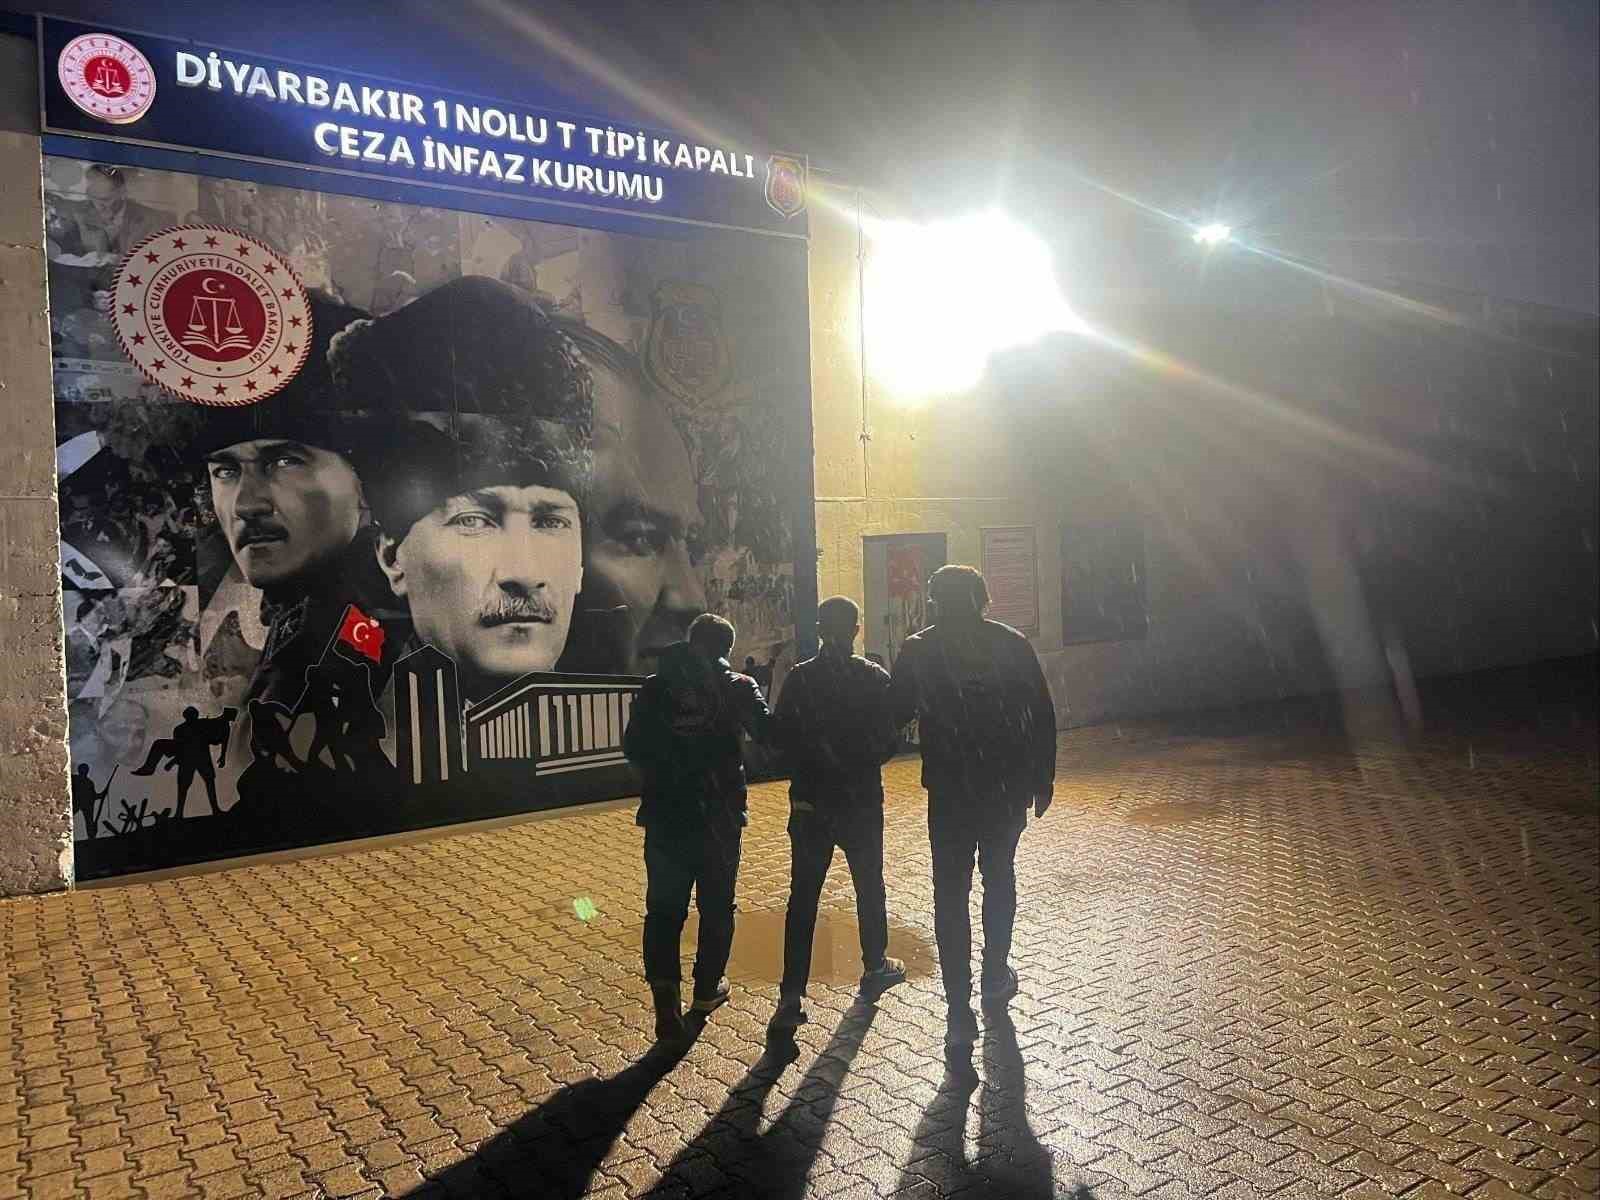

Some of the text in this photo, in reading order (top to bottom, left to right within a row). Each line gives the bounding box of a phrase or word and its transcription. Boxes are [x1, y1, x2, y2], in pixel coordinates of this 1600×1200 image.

[176, 51, 426, 124] DİYARBAKIR
[433, 100, 447, 128] 1
[455, 104, 548, 143] NOLU
[556, 122, 576, 148] T
[584, 126, 648, 160] TİPİ
[653, 140, 755, 178] KAPALI
[313, 122, 664, 202] CEZA İNFAZ KURUMU
[225, 263, 270, 298] ADALET
